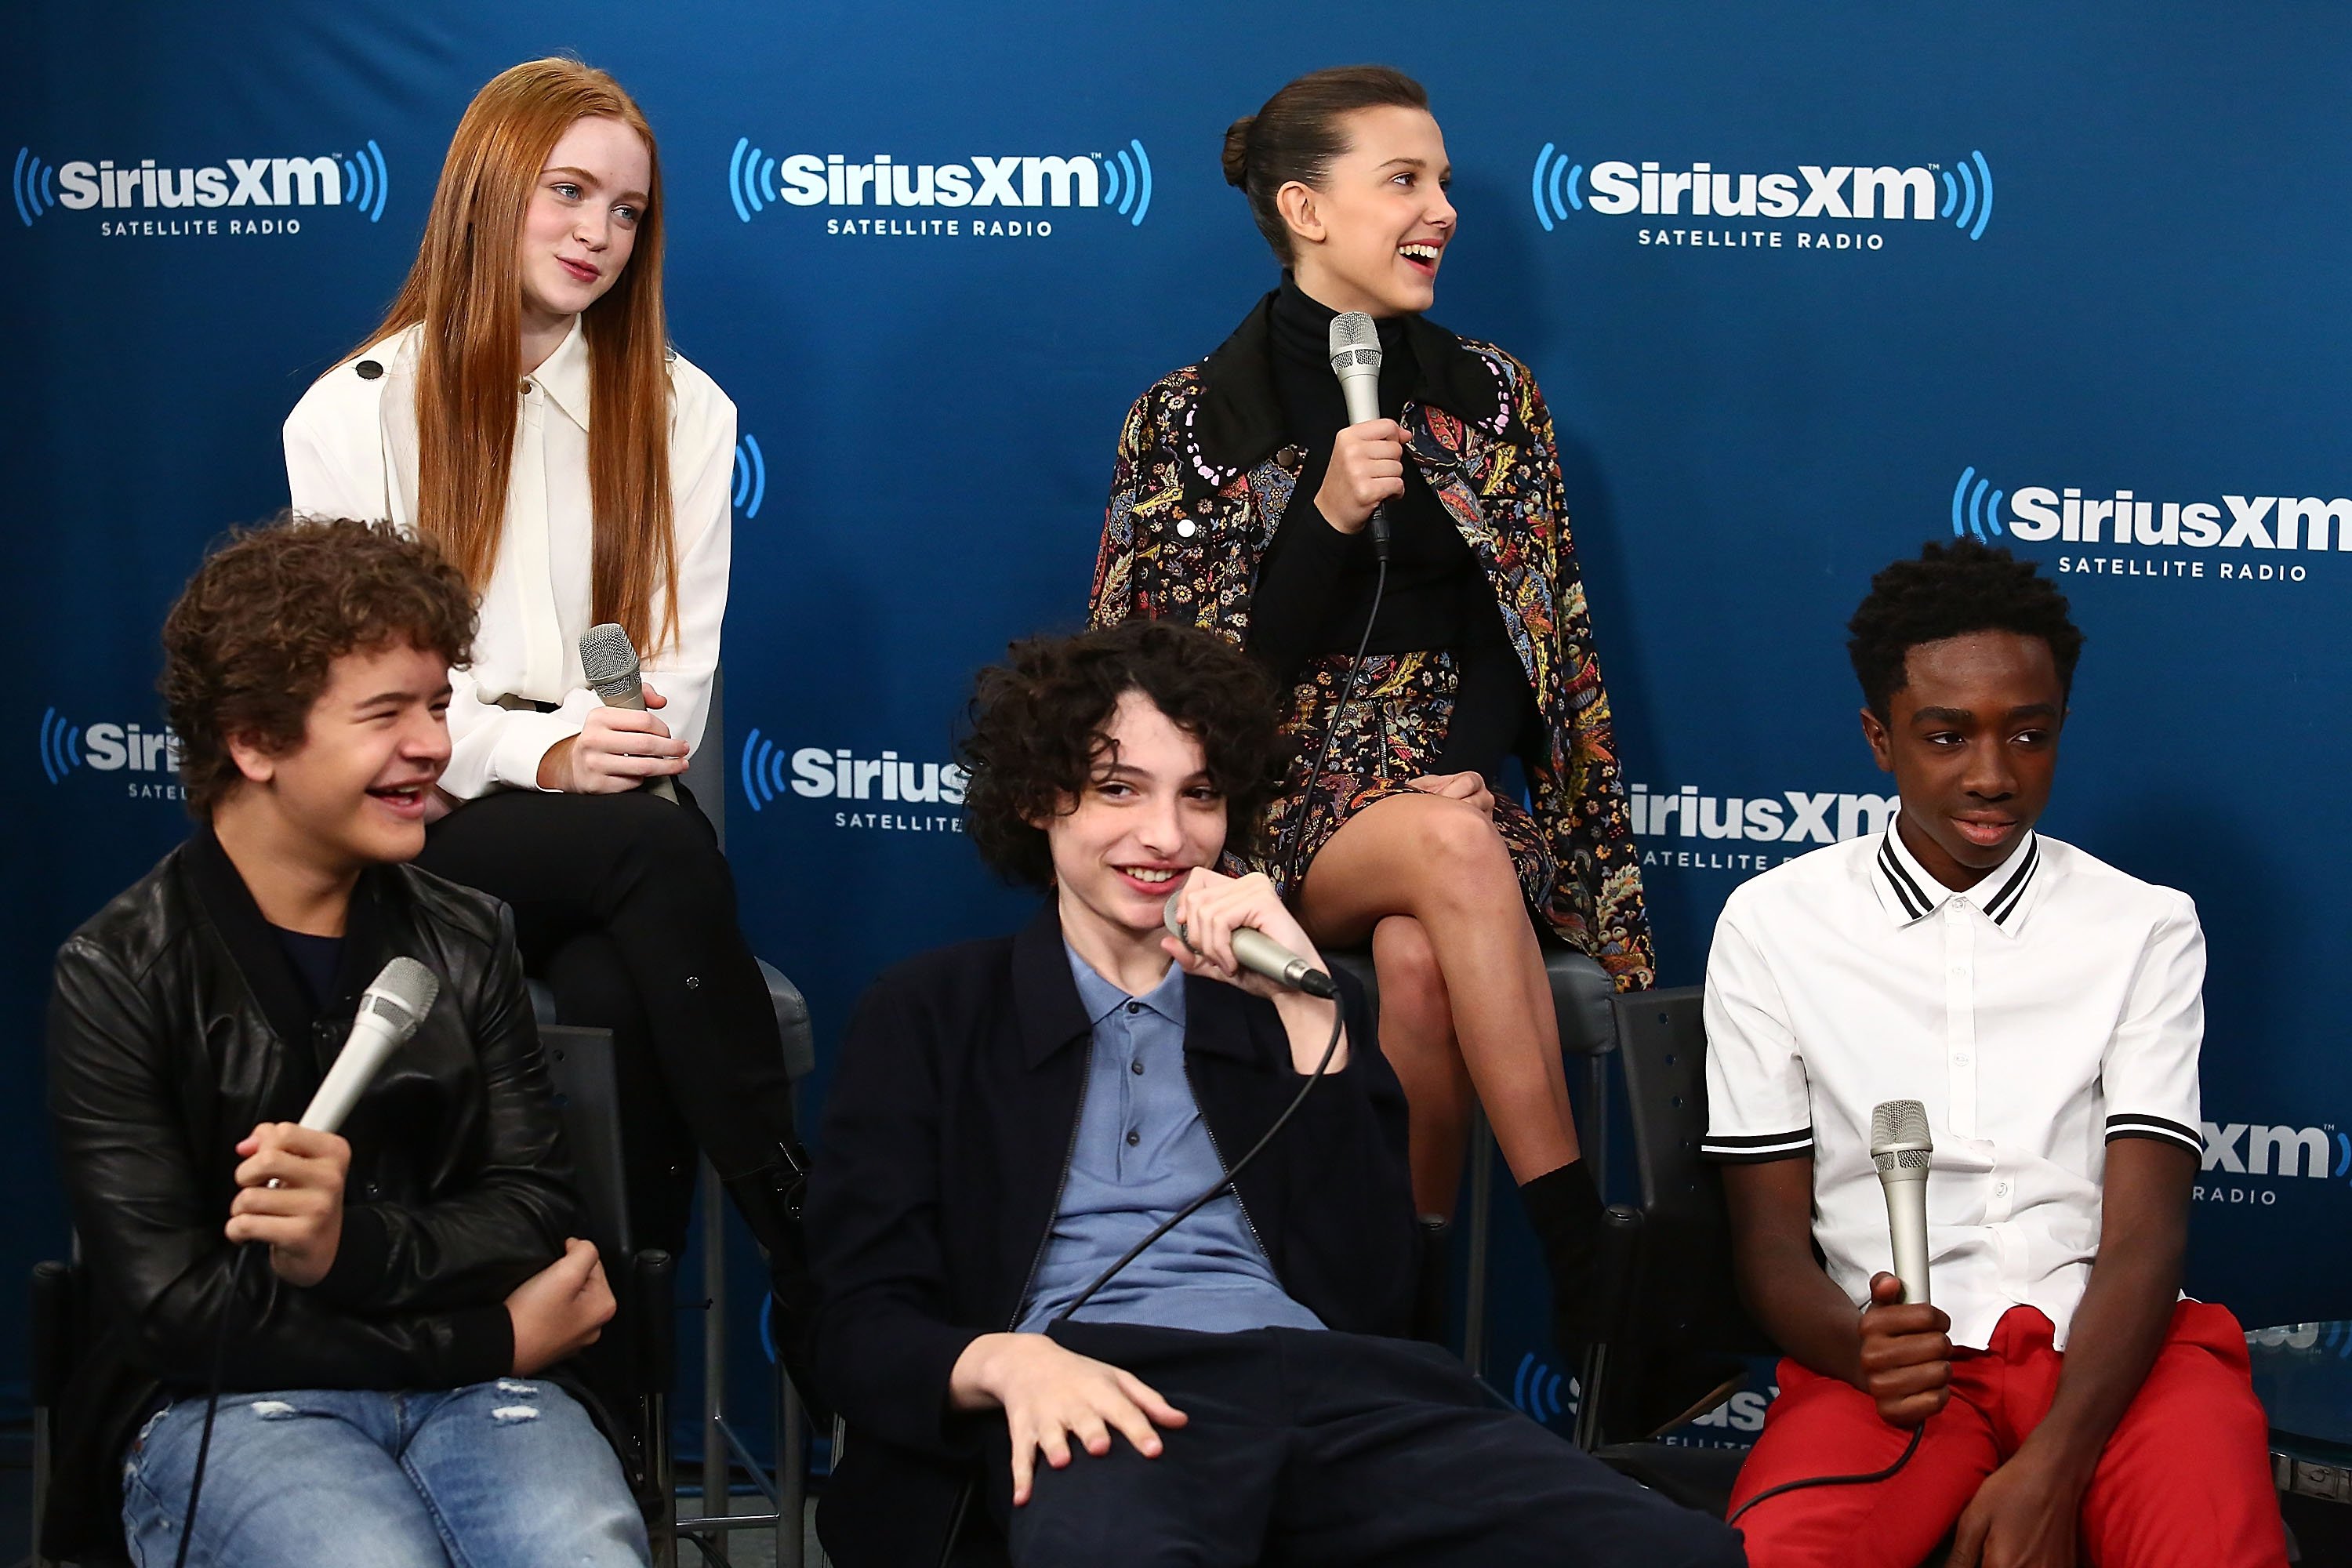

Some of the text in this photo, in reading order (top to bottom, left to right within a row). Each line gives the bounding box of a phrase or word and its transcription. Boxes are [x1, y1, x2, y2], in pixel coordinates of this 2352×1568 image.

[101, 220, 301, 236] SATELLITE RADIO
[827, 219, 1052, 237] SATELLITE RADIO
[1638, 229, 1883, 250] SATELLITE RADIO
[2059, 557, 2306, 582] SATELLITE RADIO
[85, 723, 183, 772] Siri
[790, 747, 972, 805] Sirius
[128, 783, 187, 800] SATEL
[835, 812, 963, 833] SATELLITE
[1643, 851, 1767, 870] ATELLITE
[2192, 1185, 2276, 1205] RADIO
